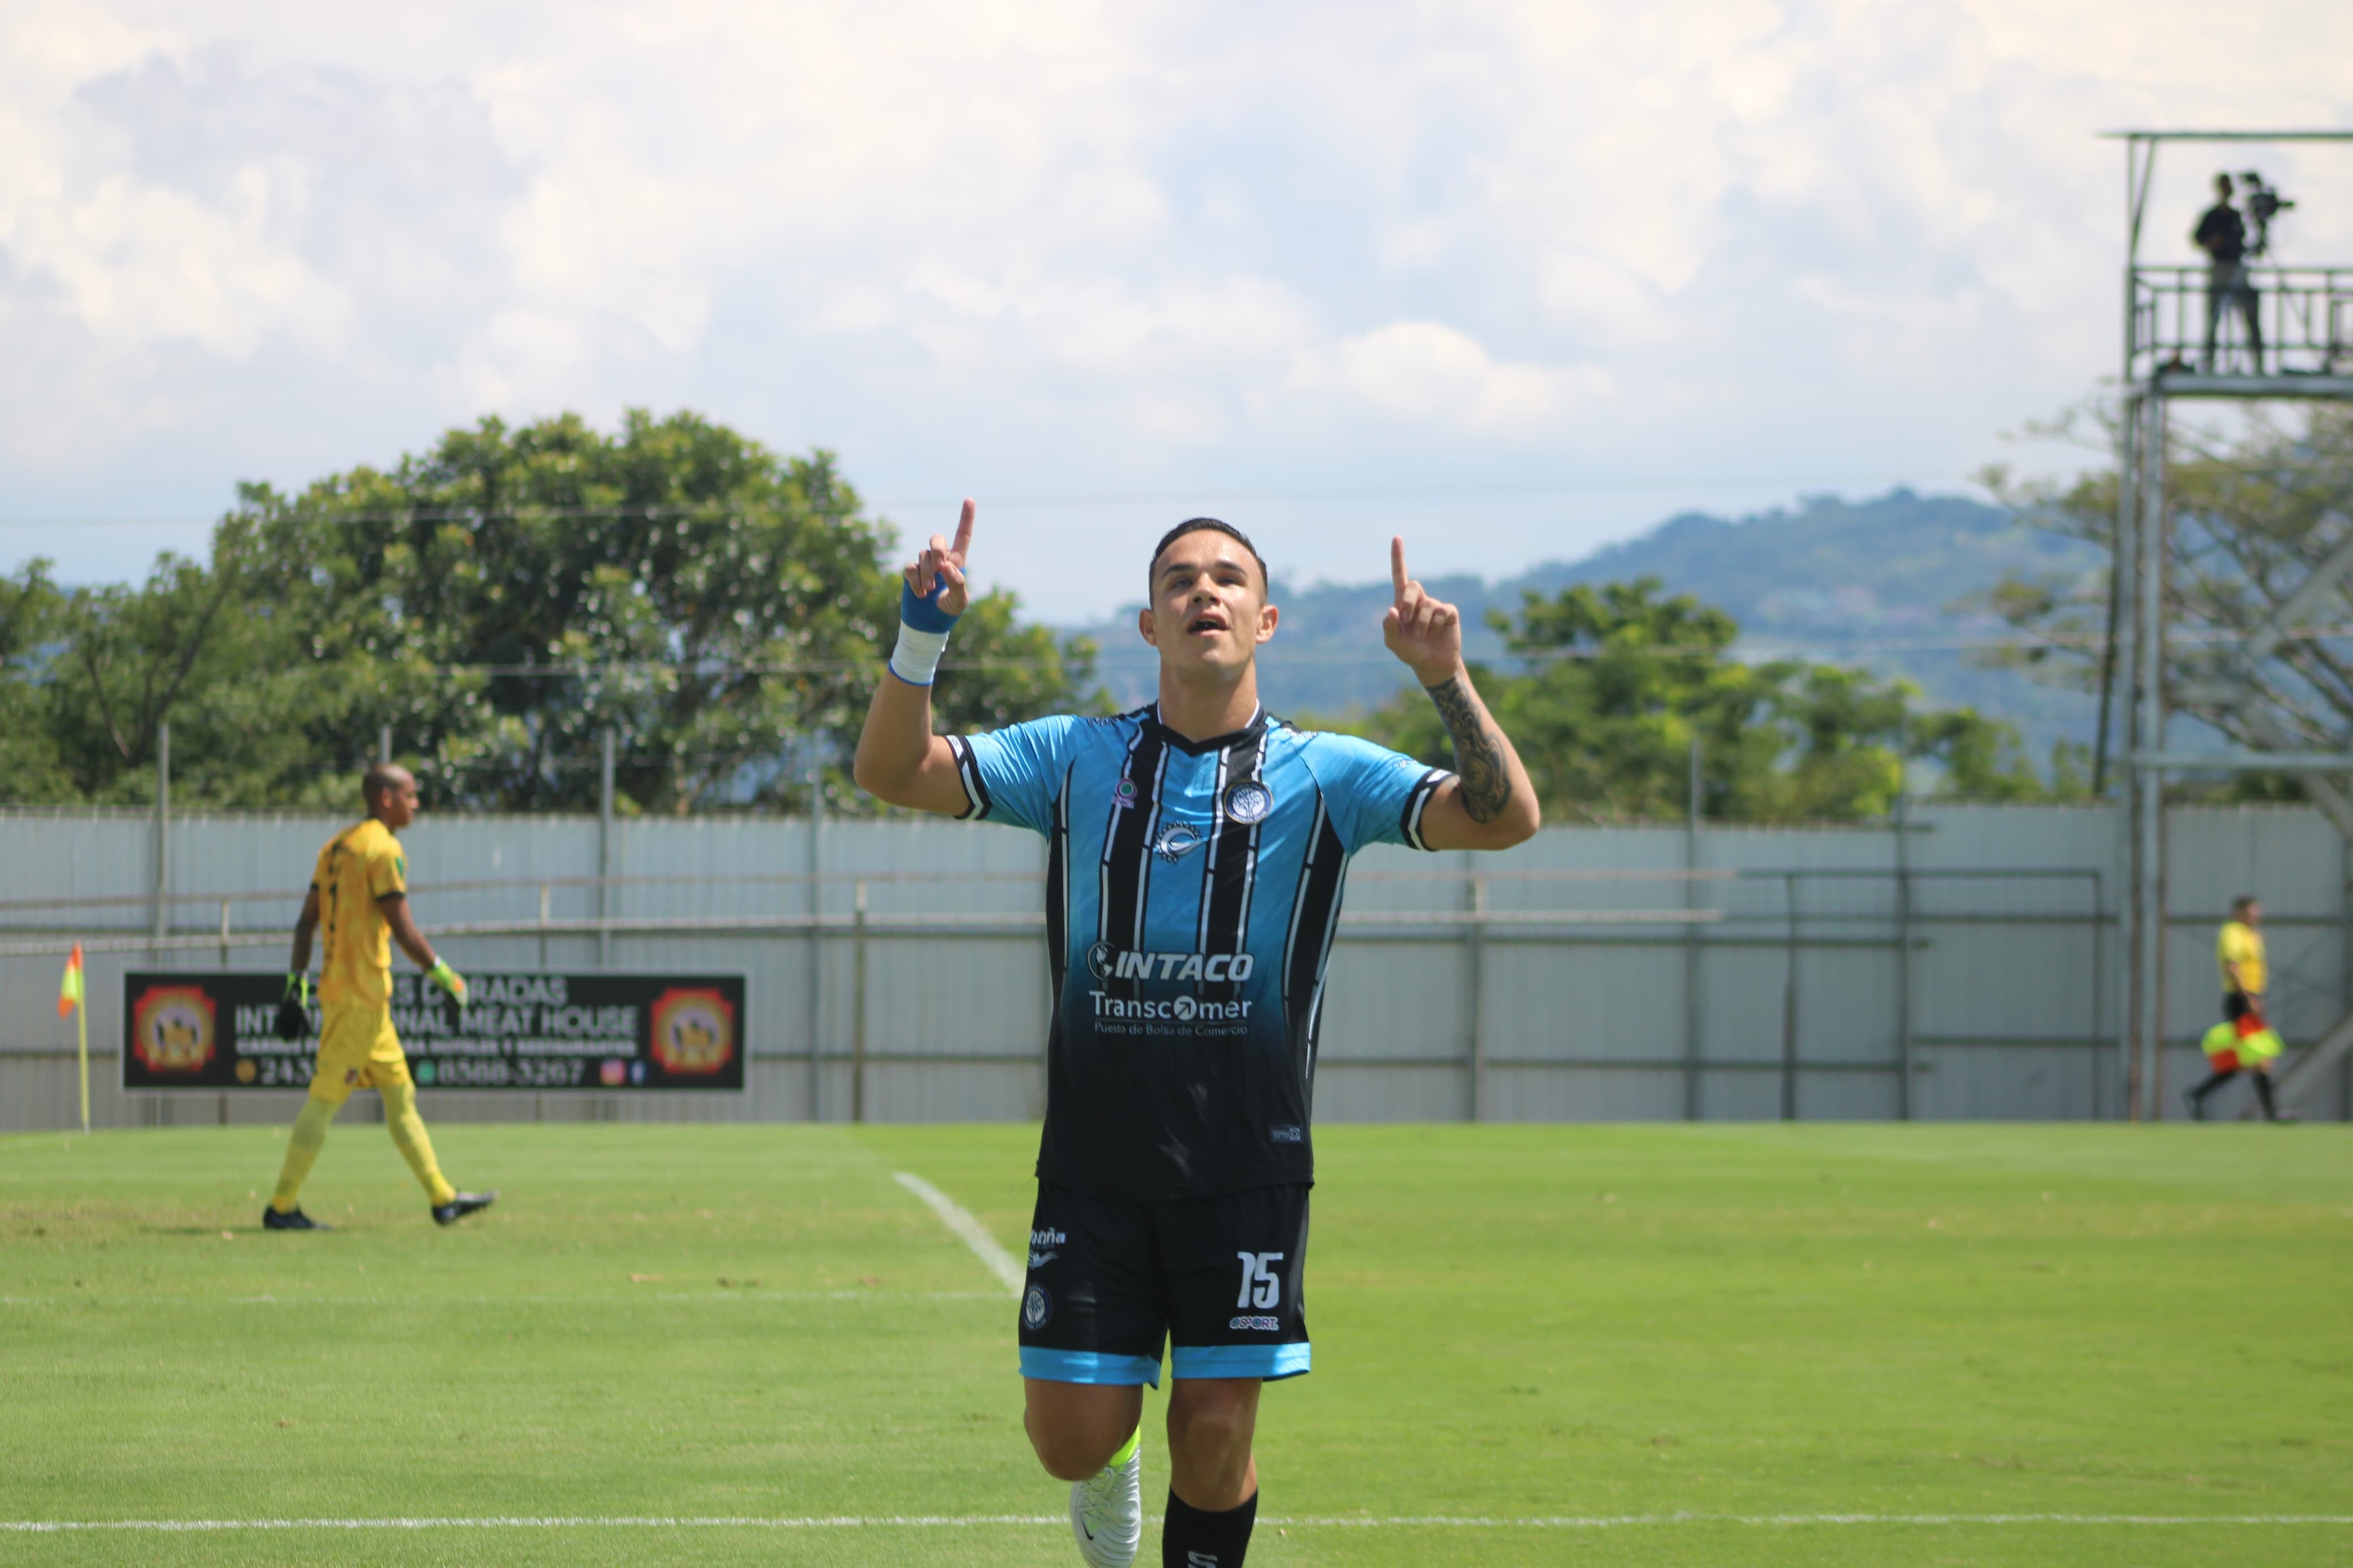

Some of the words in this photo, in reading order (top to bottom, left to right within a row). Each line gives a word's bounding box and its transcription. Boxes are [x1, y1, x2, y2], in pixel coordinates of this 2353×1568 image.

[1115, 951, 1254, 982] INTACO
[421, 976, 567, 1005] DRADAS
[459, 1006, 533, 1035] MEAT
[541, 1004, 637, 1036] HOUSE
[1094, 1021, 1126, 1033] Puesto
[1129, 1023, 1143, 1035] de
[1147, 1024, 1174, 1036] Bolsa
[1178, 1025, 1192, 1036] de
[1195, 1024, 1248, 1036] Comercio
[1237, 1251, 1284, 1309] 15
